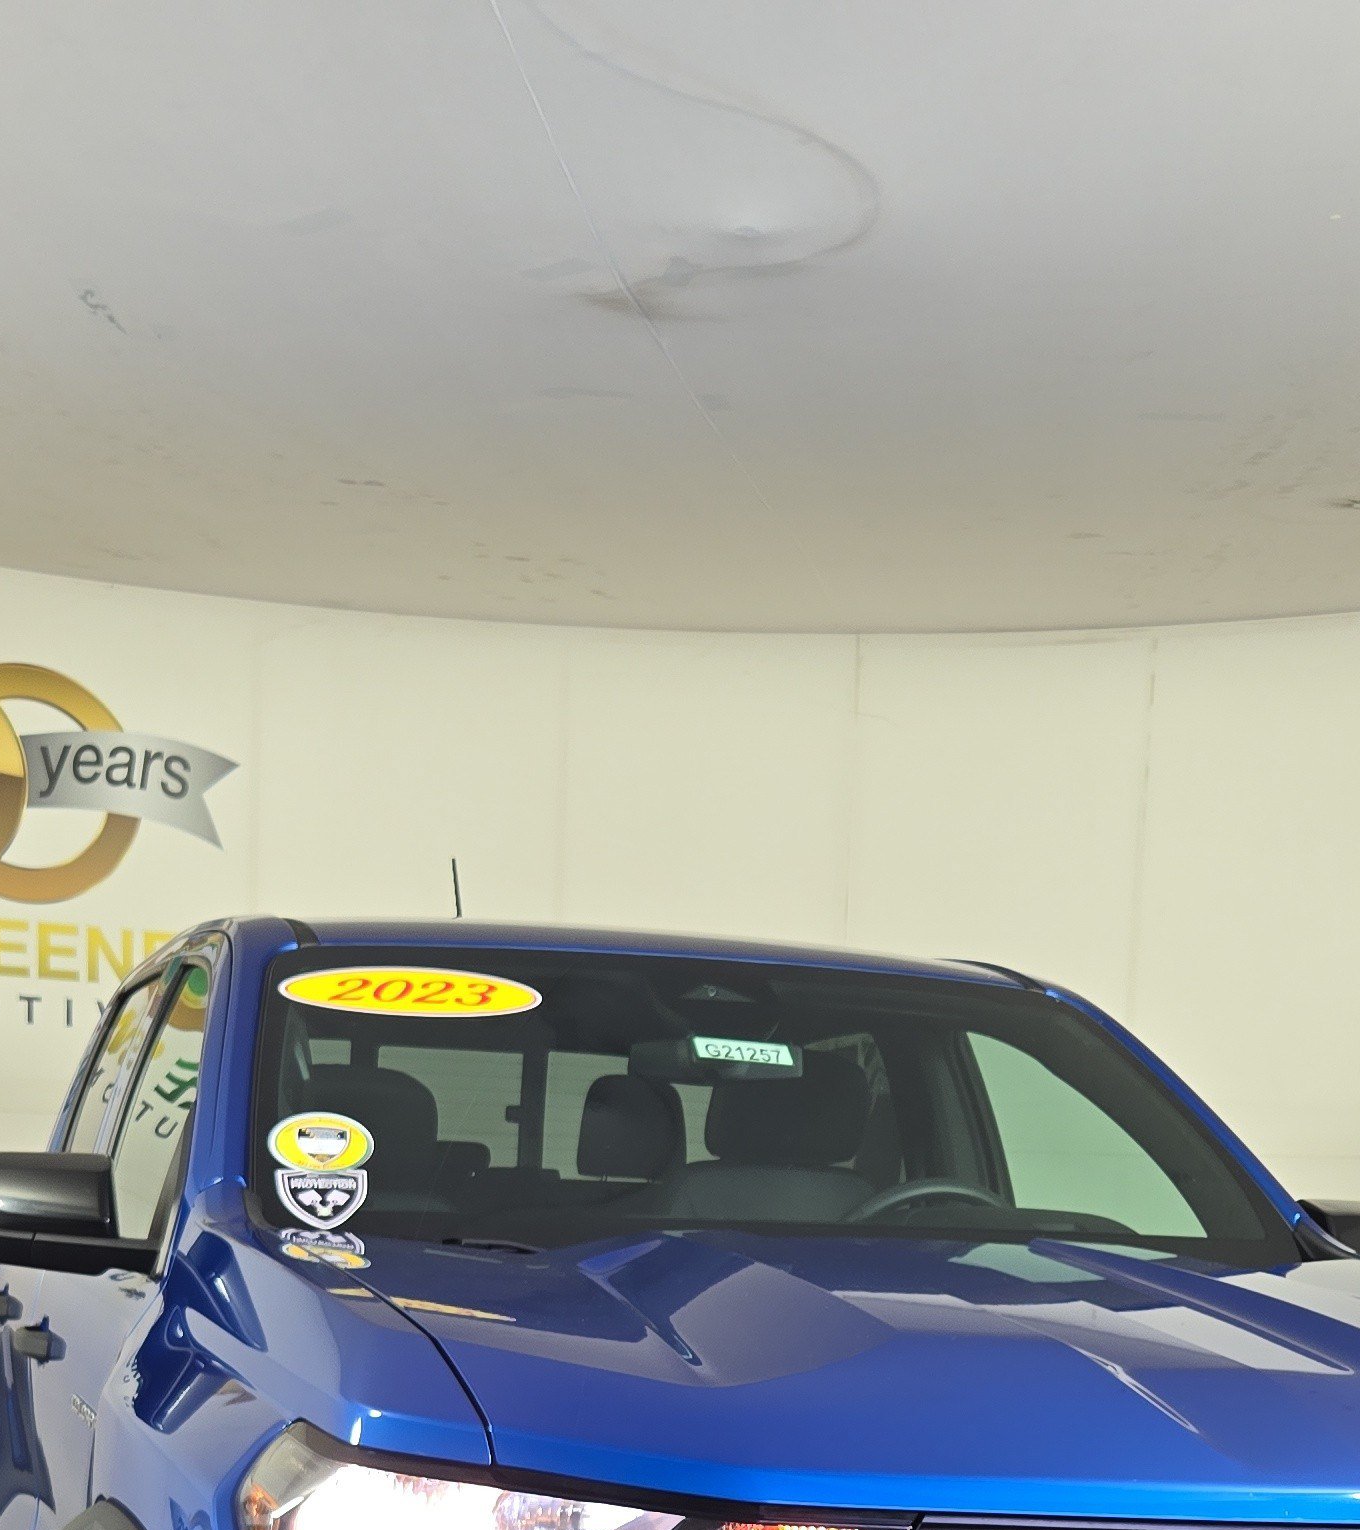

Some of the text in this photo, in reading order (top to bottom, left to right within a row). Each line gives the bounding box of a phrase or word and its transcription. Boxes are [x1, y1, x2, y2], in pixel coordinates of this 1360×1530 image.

[36, 742, 193, 800] years
[328, 978, 498, 1006] 2023
[705, 1043, 781, 1063] G21257
